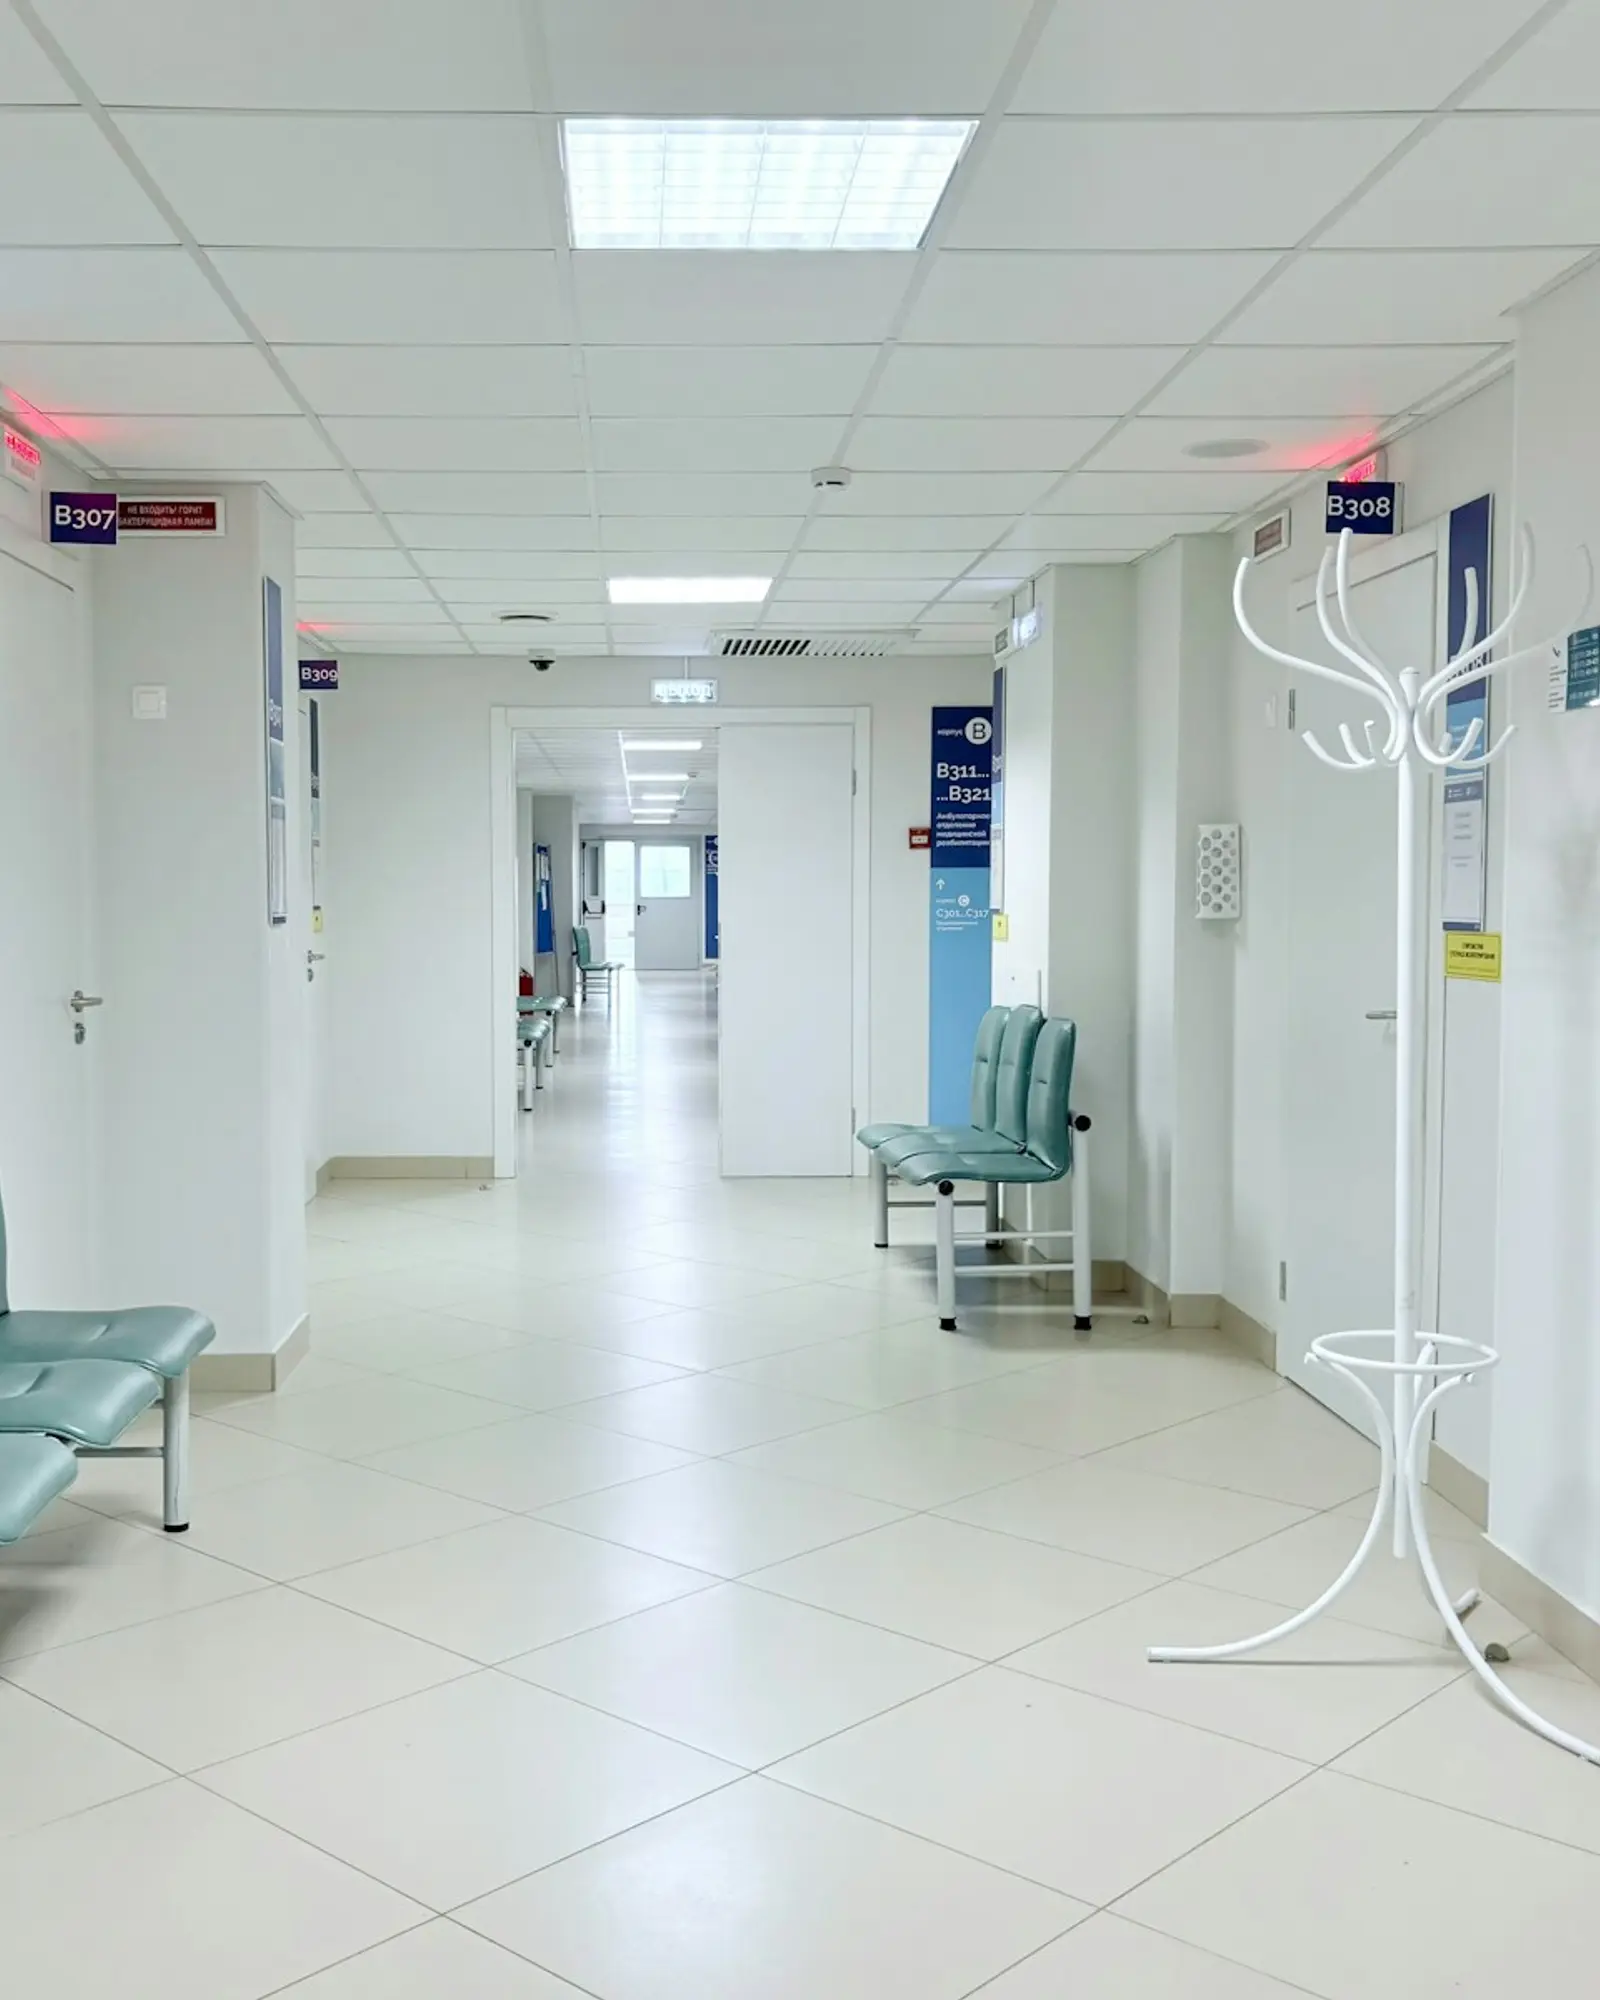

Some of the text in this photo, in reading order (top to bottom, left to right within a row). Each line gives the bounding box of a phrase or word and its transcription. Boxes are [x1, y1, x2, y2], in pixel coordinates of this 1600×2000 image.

[55, 504, 116, 530] B307
[1327, 495, 1391, 520] B308
[301, 667, 338, 682] B309
